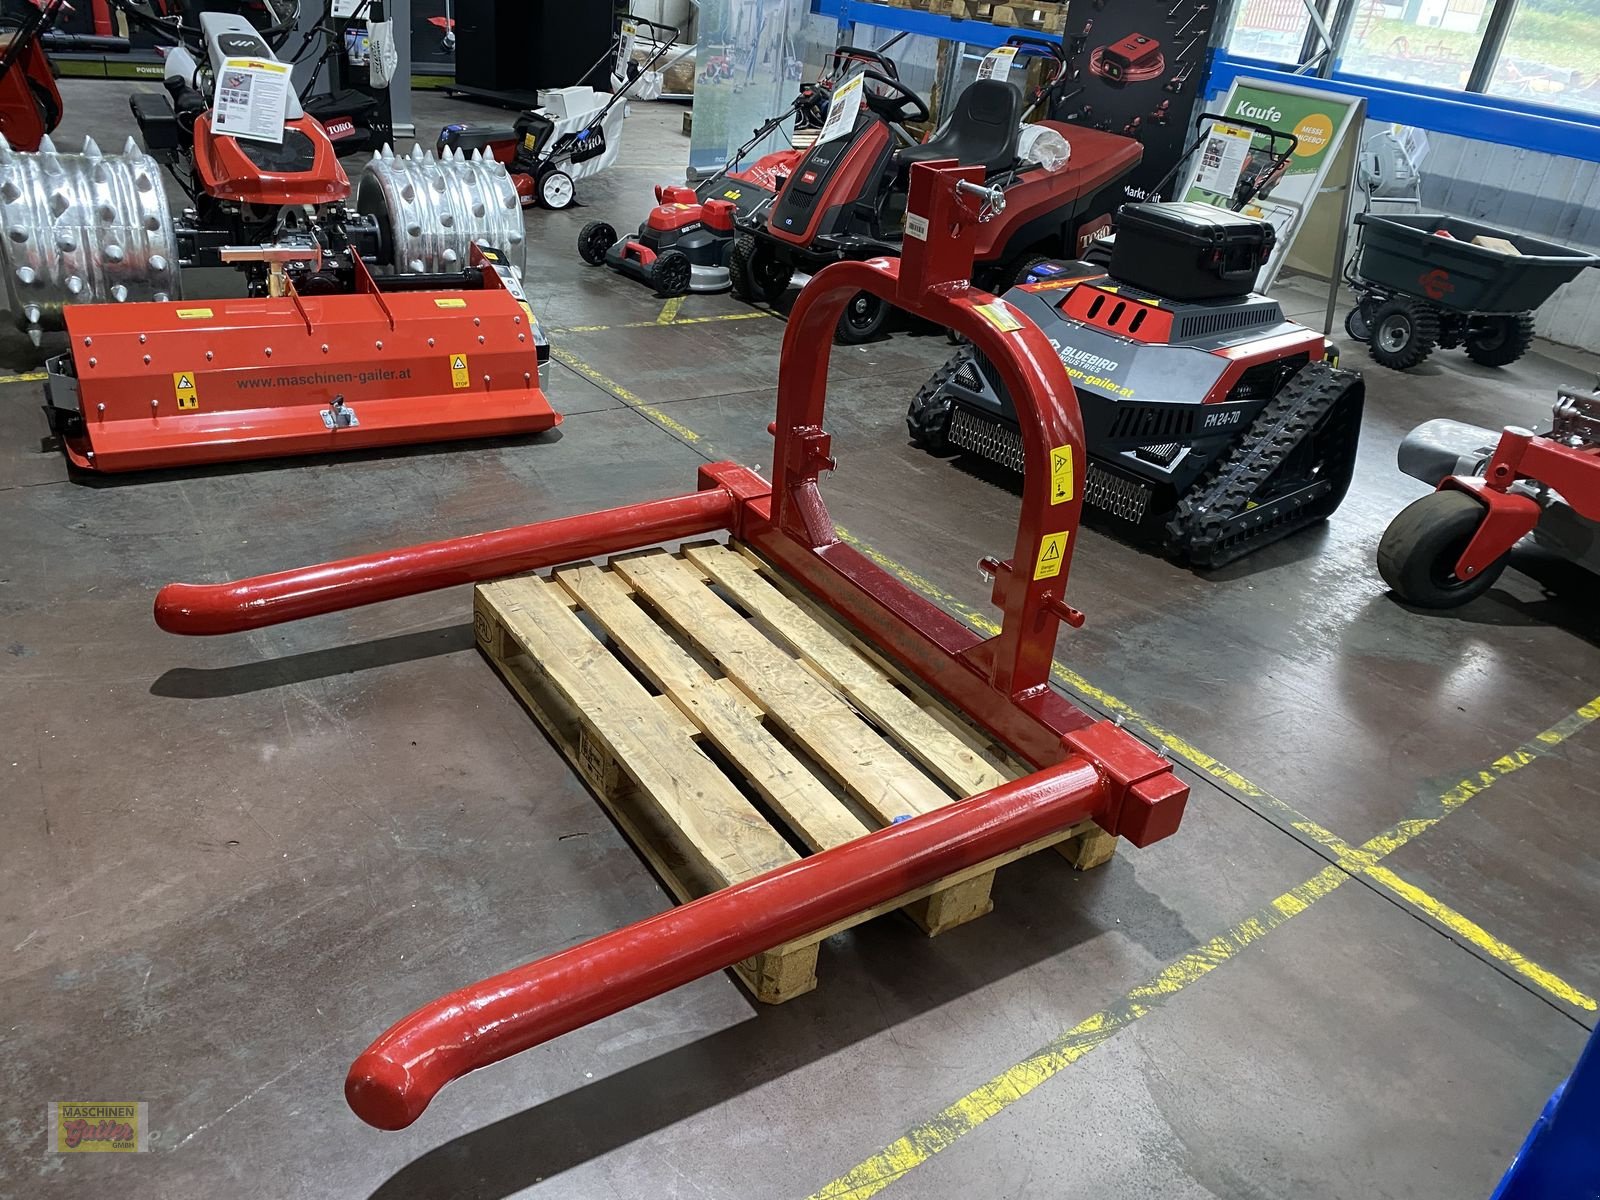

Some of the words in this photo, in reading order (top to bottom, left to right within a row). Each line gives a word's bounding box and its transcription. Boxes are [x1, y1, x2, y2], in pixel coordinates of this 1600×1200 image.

[1235, 100, 1282, 123] Kaufe
[326, 121, 353, 136] TORO
[1301, 125, 1324, 136] MESSE
[1124, 185, 1145, 200] Markt
[1058, 353, 1102, 374] INDUSTRIES
[1060, 345, 1118, 372] BLUEBIRD
[236, 367, 412, 389] www.maschinen-gailer.at
[1203, 413, 1219, 428] FM
[1217, 410, 1241, 426] 24-70
